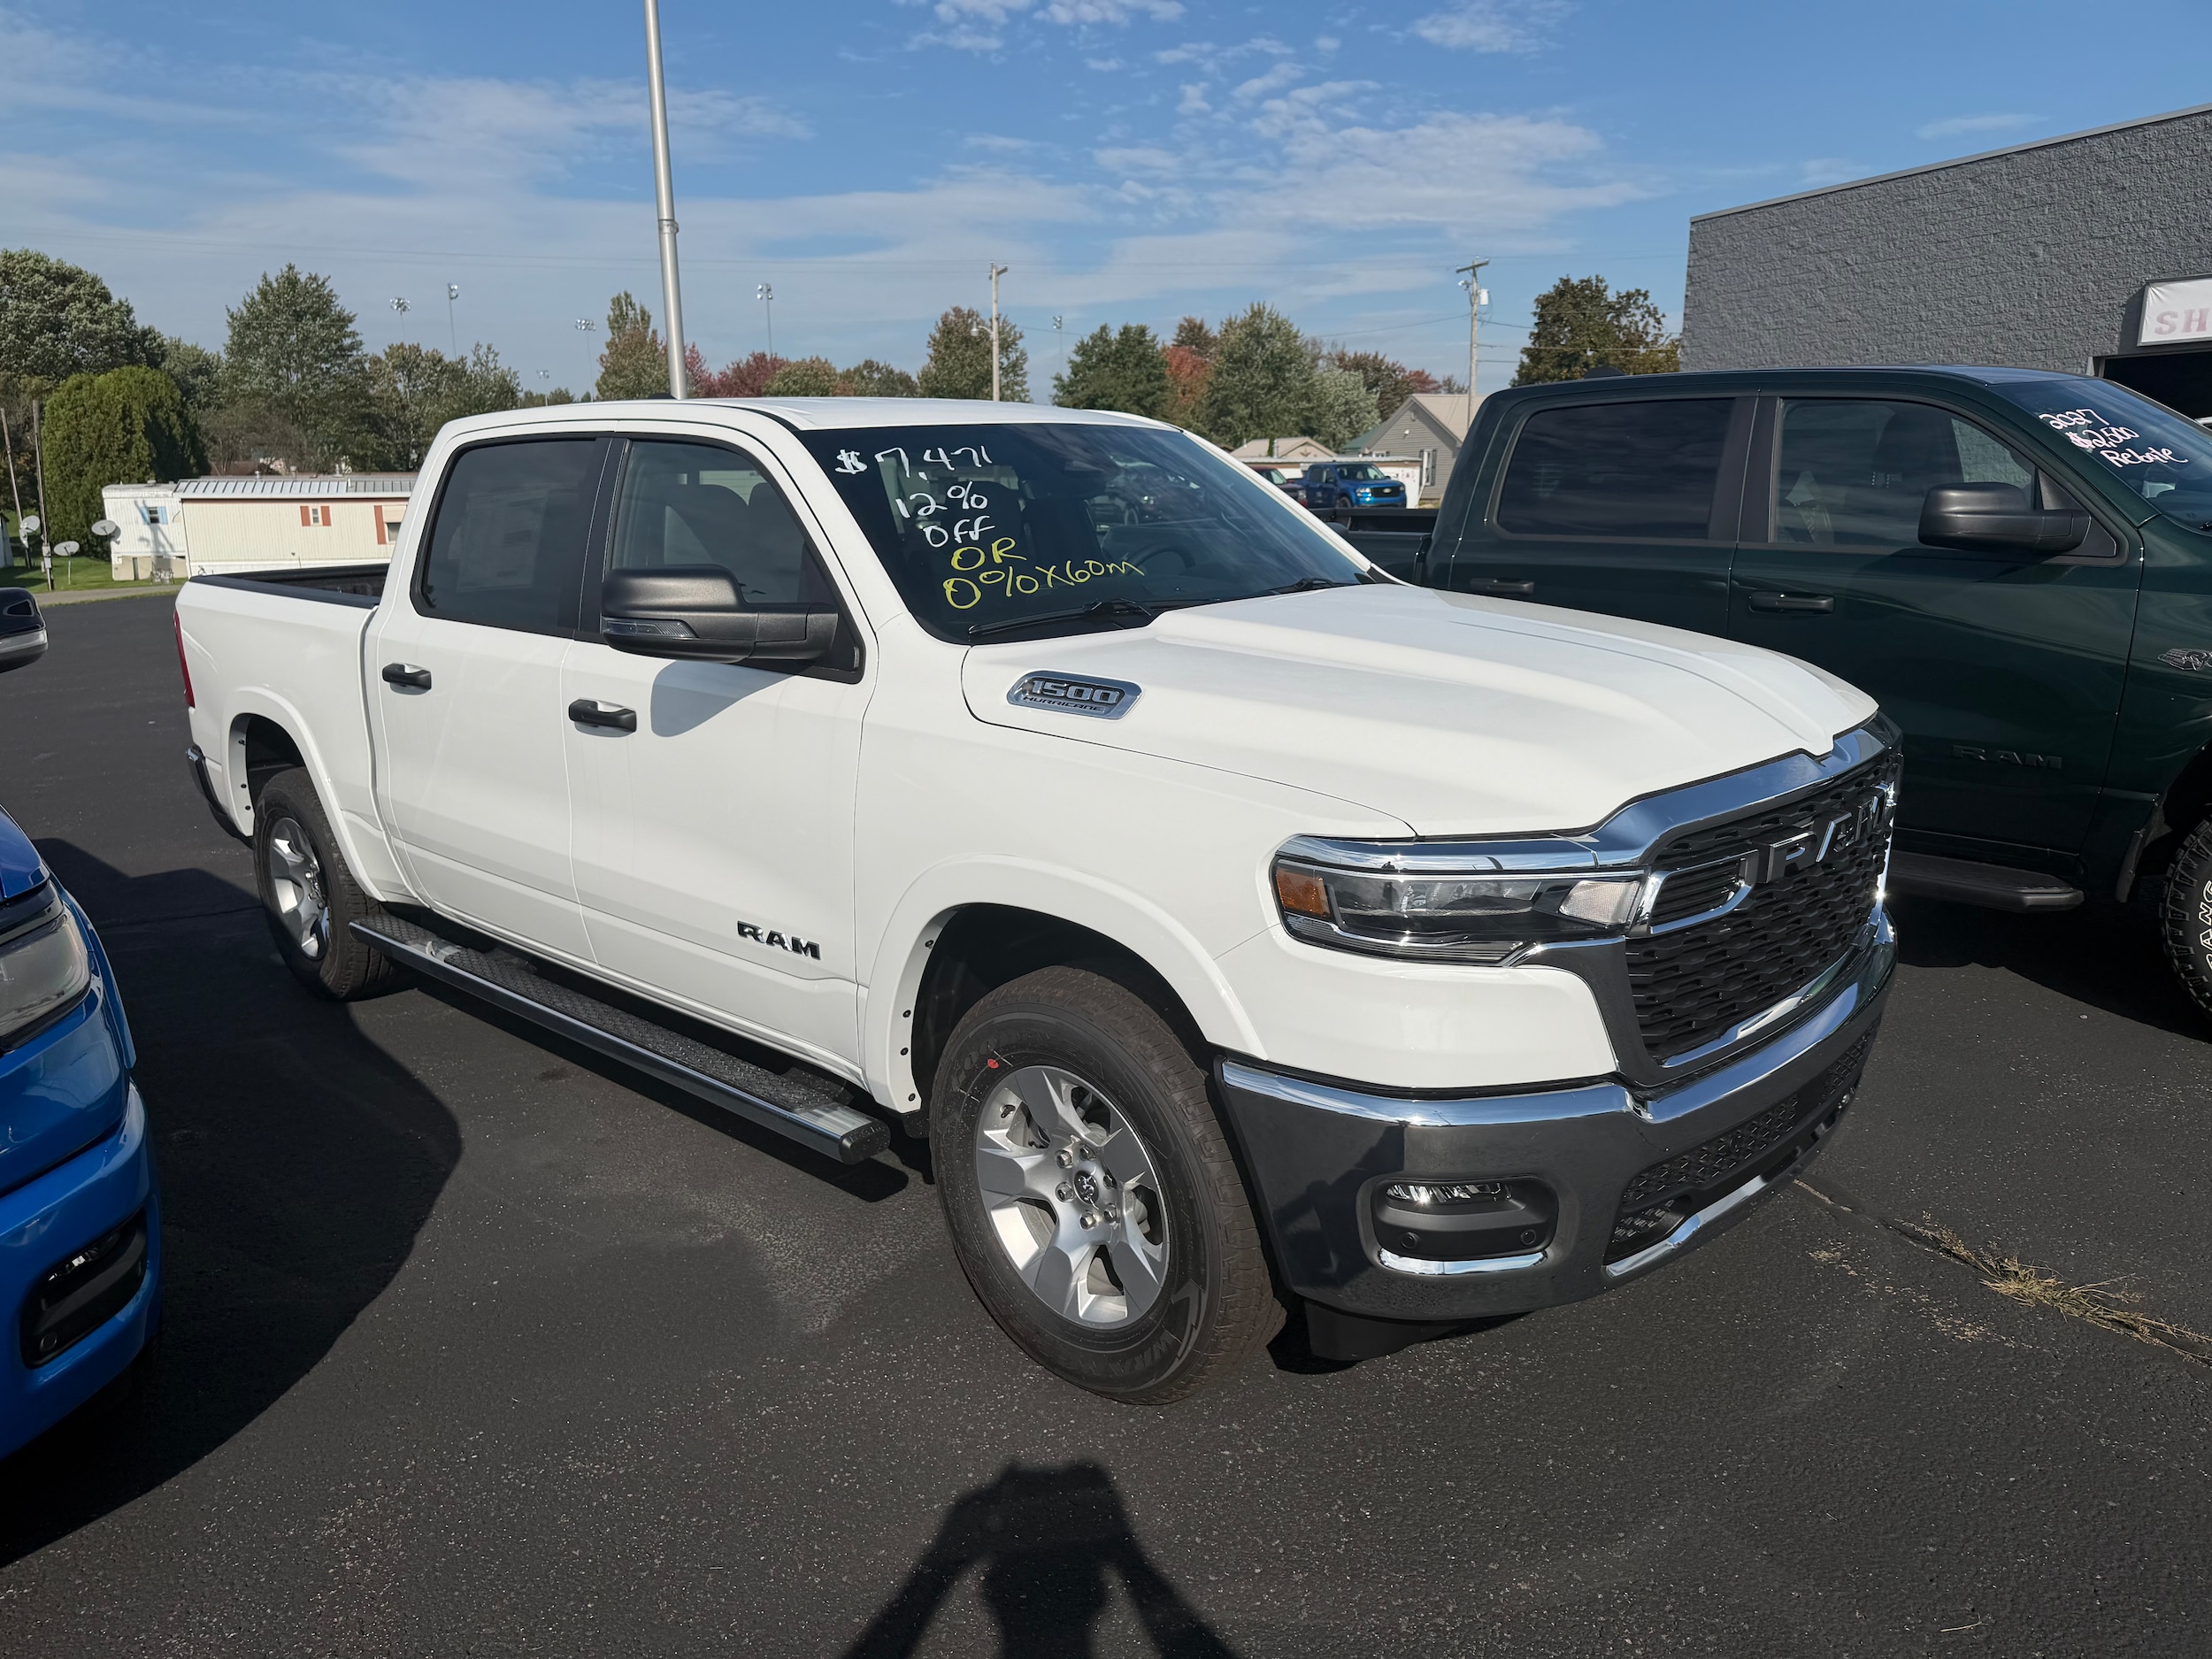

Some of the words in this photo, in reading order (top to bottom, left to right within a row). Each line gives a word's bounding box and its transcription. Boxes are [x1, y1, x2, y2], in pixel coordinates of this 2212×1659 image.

[2039, 409, 2109, 430] 2027
[2065, 426, 2139, 449] $2,500
[2100, 447, 2189, 468] Rebate
[895, 481, 988, 518] 12%
[951, 537, 1027, 571] OR
[1022, 695, 1102, 712] HURRICANE
[1032, 680, 1120, 705] 1500
[1952, 744, 2062, 769] RAM
[737, 920, 821, 961] RAM
